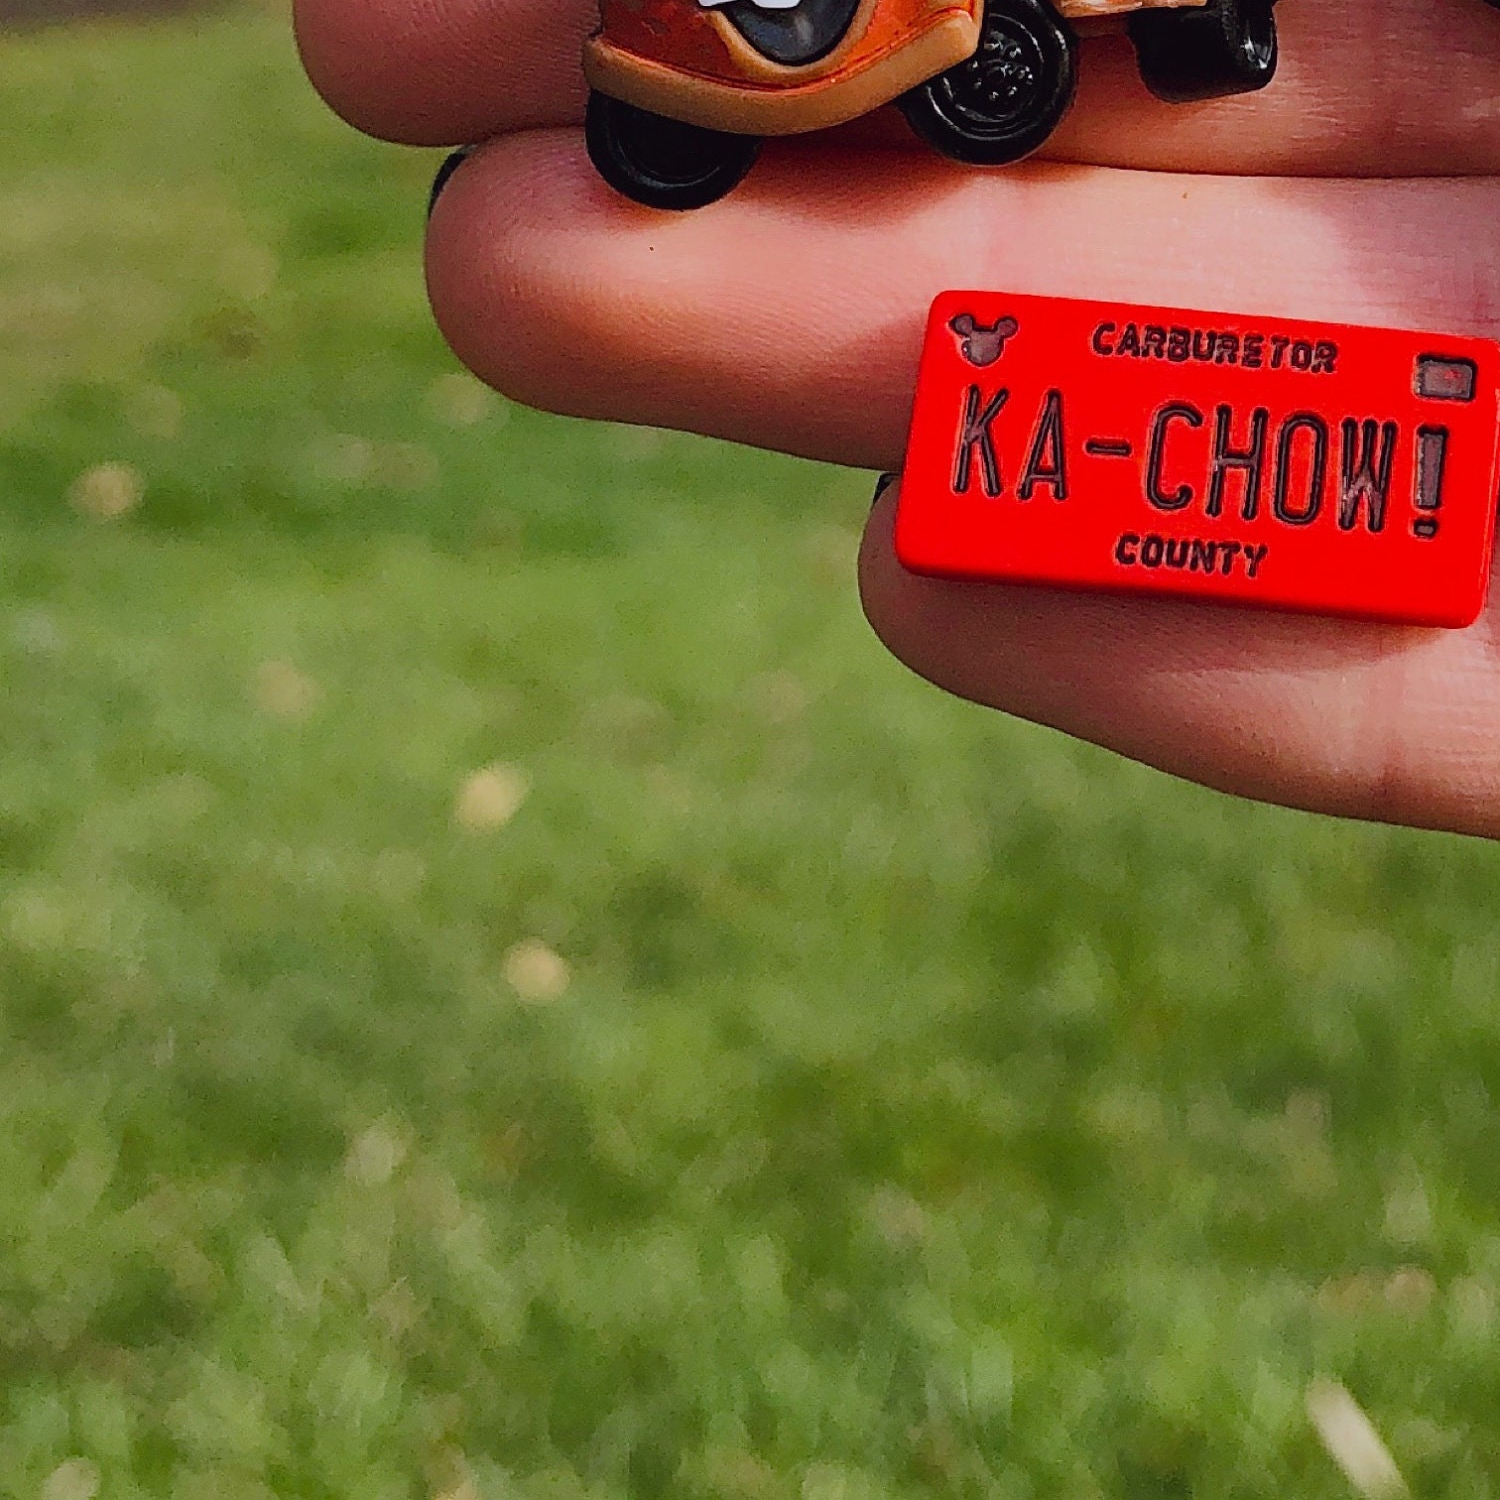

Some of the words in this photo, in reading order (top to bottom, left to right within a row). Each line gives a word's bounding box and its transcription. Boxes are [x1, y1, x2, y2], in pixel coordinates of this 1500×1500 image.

[1092, 322, 1338, 373] CARBURETOR
[951, 384, 1449, 539] KA-CHOW!
[1115, 534, 1268, 578] COUNTY
